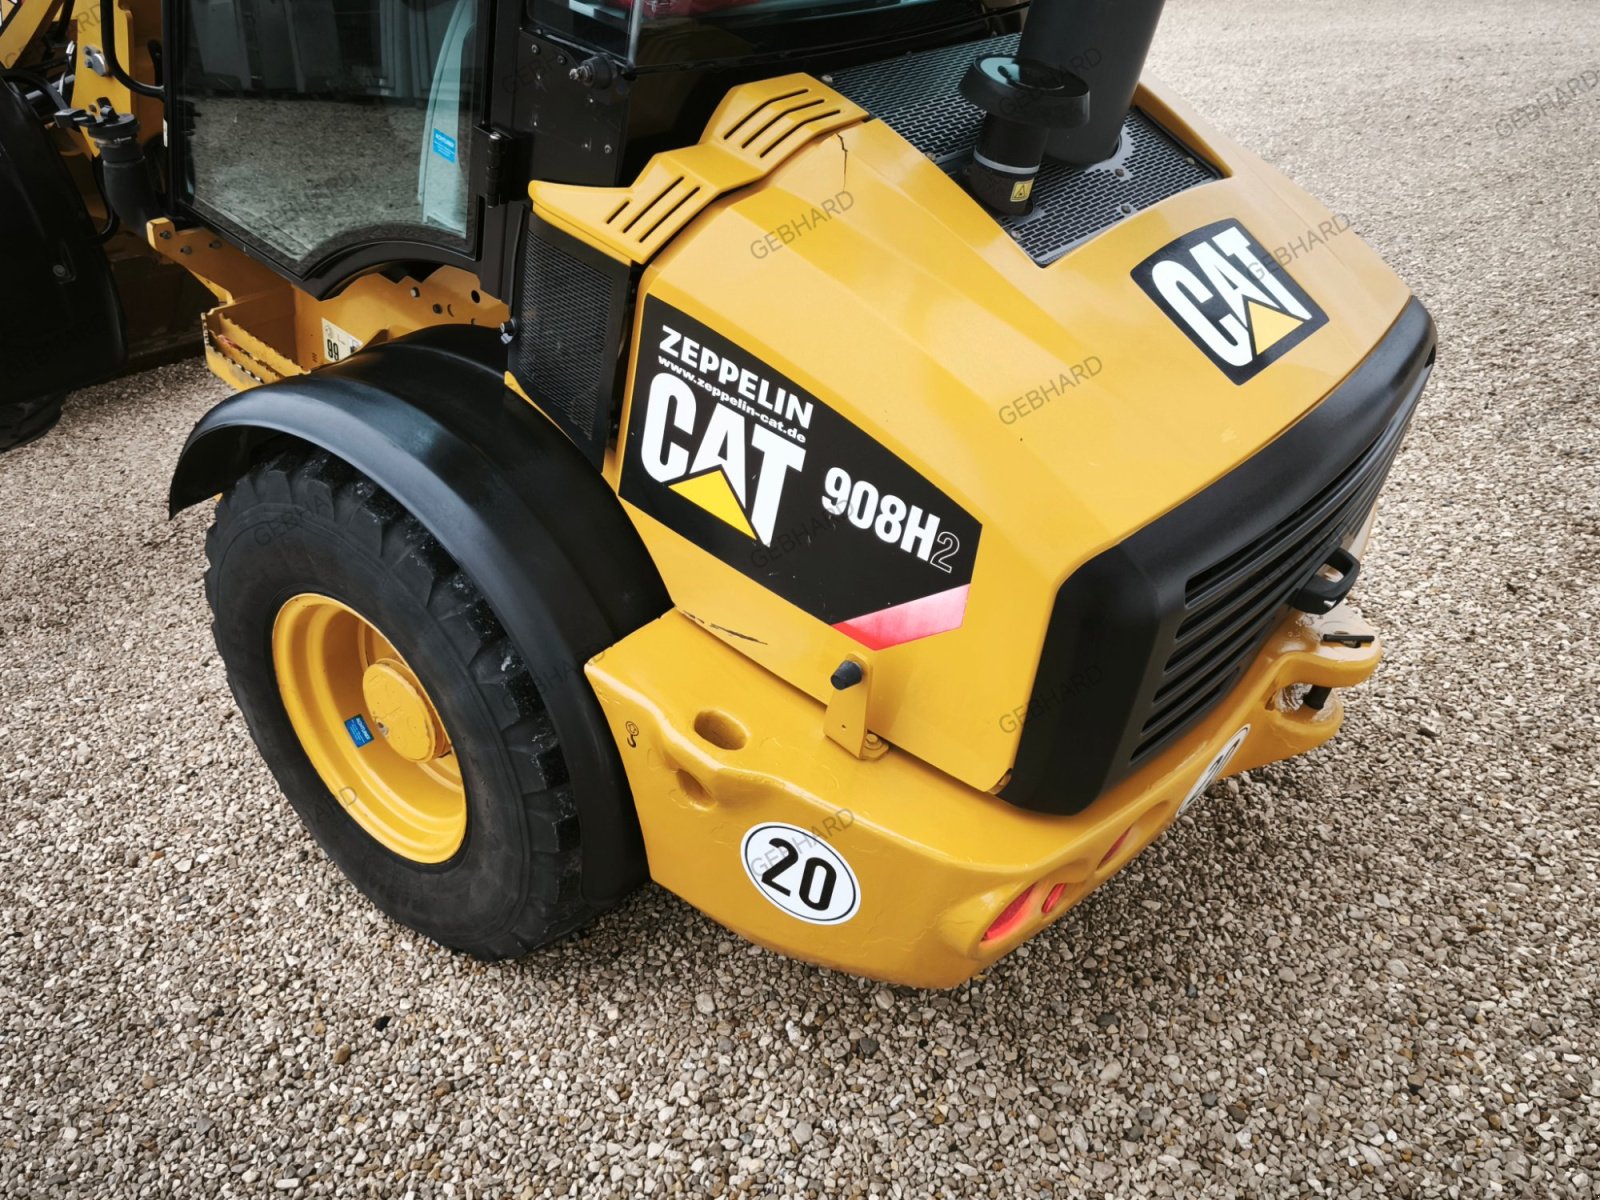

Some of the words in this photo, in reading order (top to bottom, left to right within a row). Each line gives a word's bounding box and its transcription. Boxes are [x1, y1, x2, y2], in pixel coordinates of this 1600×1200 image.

[1152, 226, 1312, 367] CAT
[658, 355, 807, 443] www.zeppelin-cat.de
[659, 325, 814, 429] ZEPPELIN
[641, 372, 806, 548] CAT
[761, 837, 837, 911] 20
